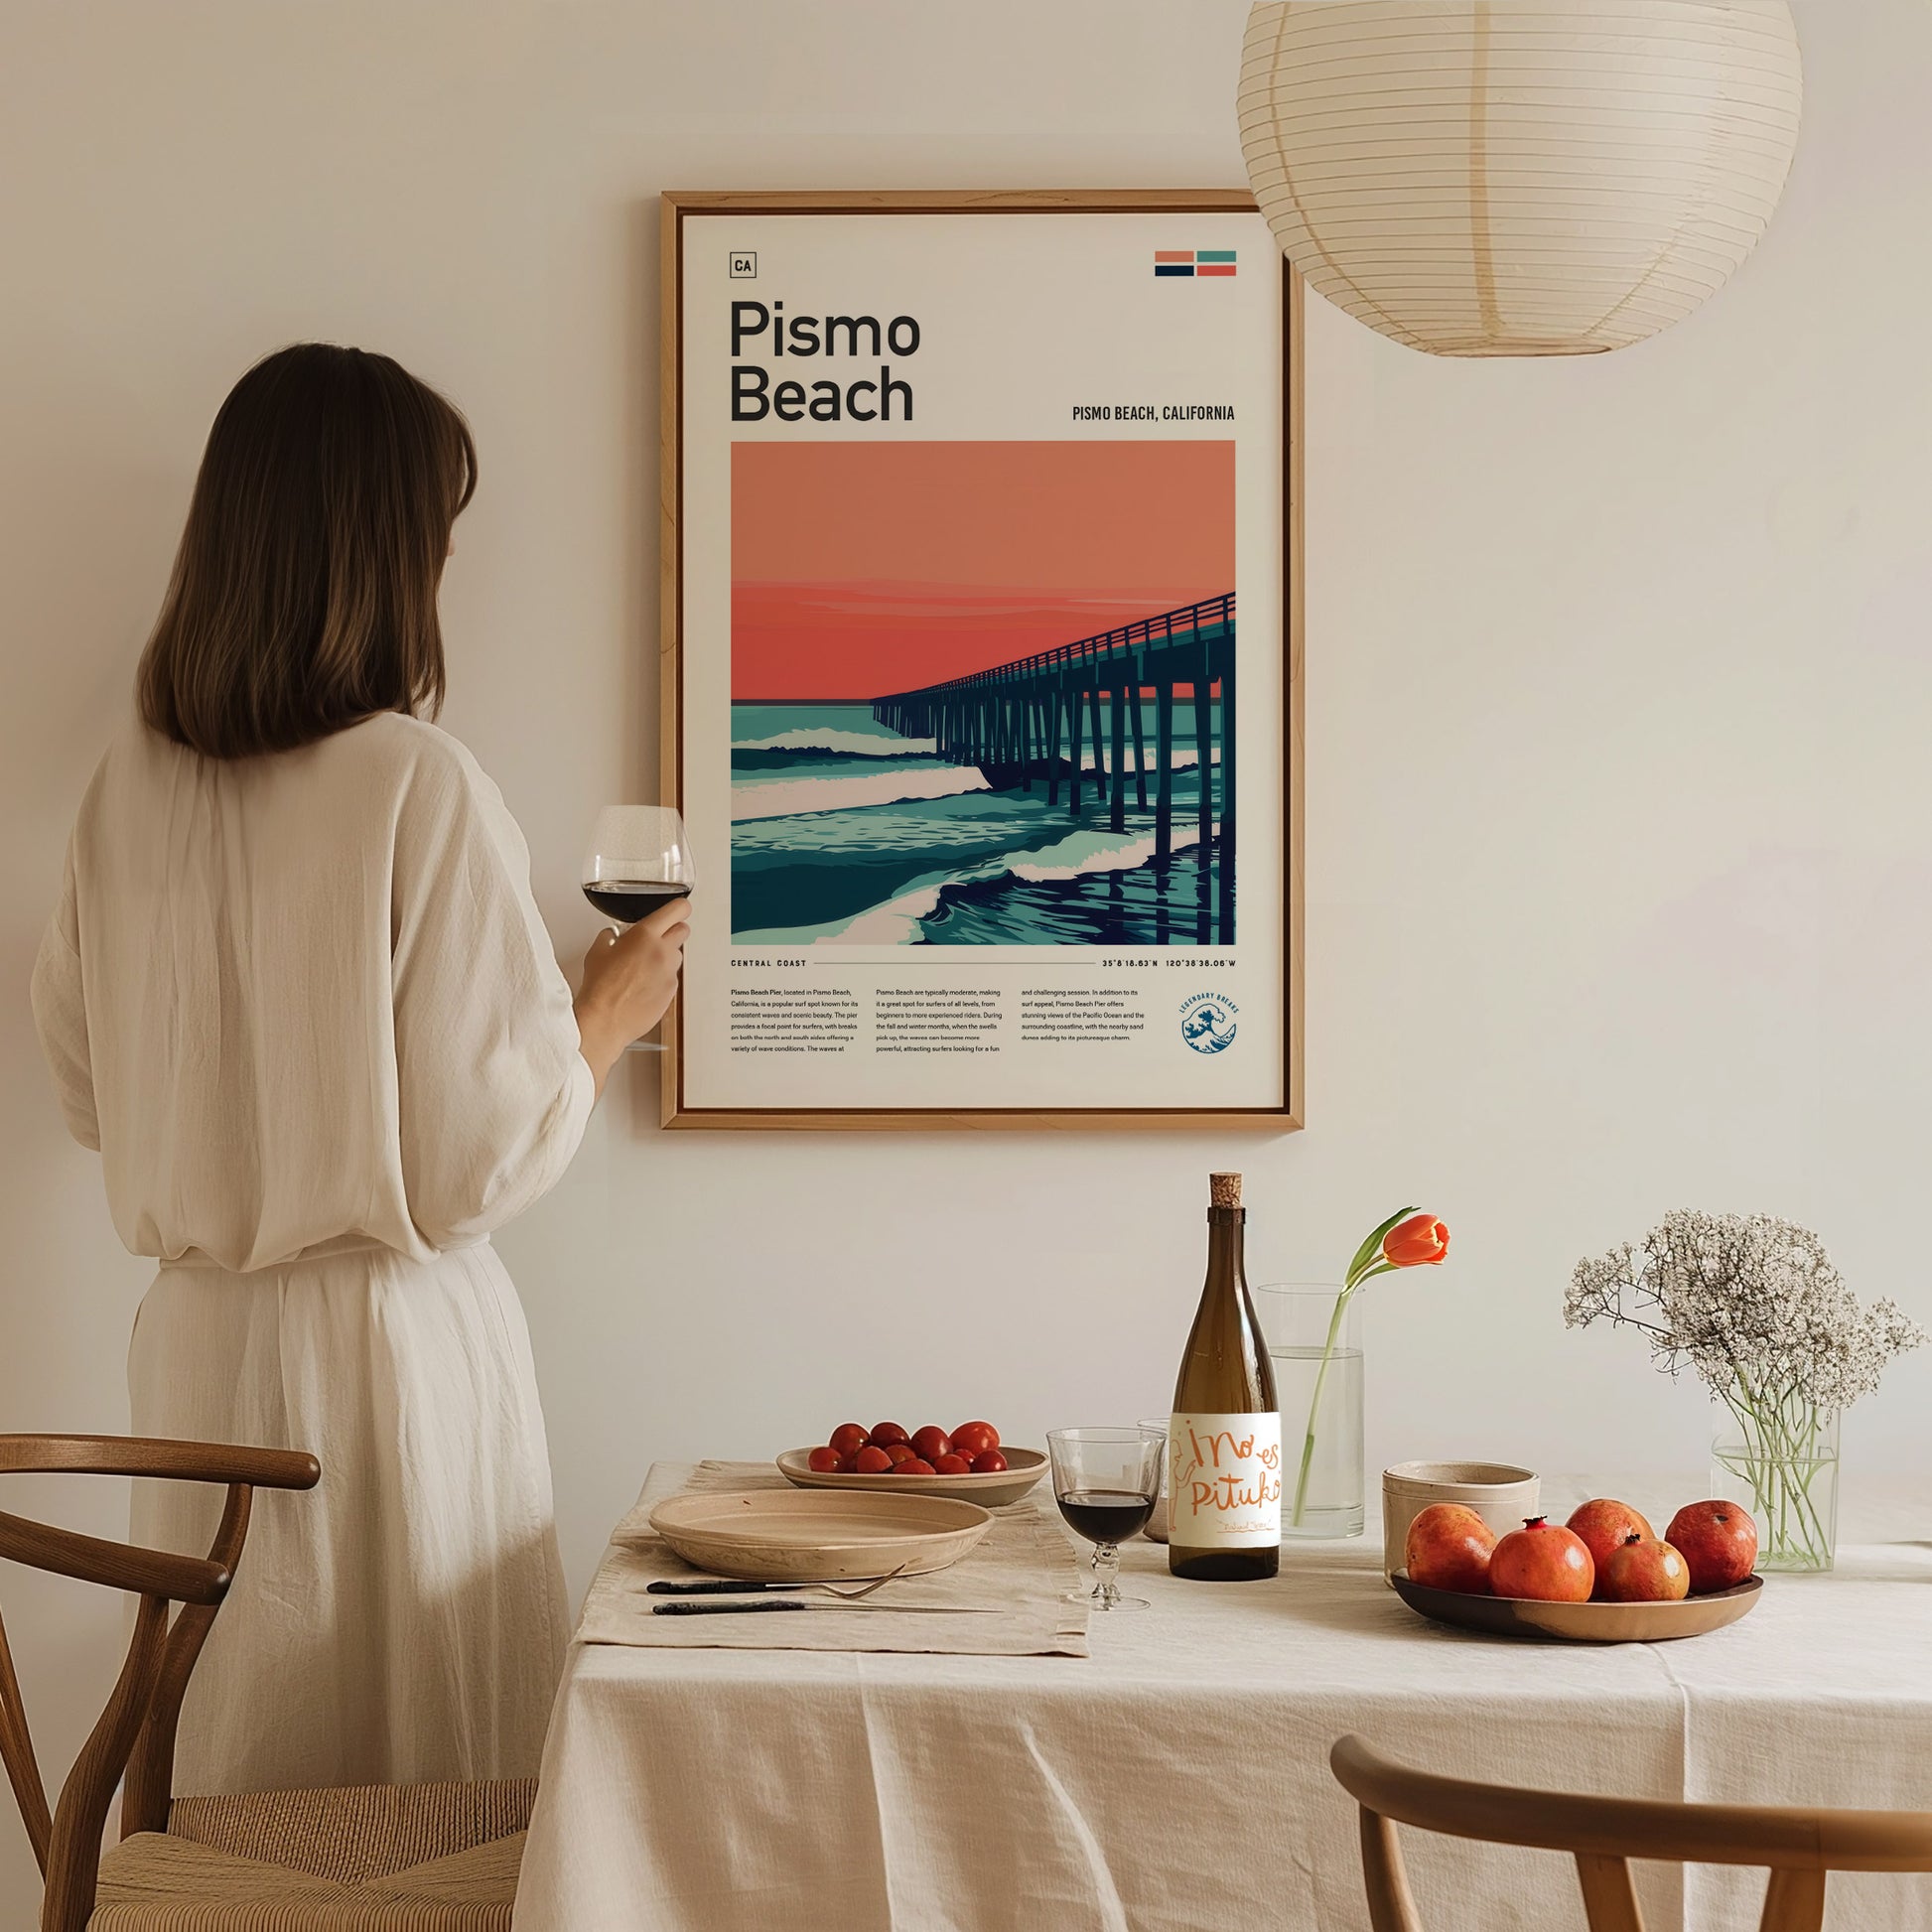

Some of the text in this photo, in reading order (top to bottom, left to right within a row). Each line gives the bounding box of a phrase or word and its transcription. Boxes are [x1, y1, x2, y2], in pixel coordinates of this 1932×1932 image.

[735, 260, 752, 271] CA
[731, 301, 920, 356] Pismo
[731, 365, 912, 421] Beach
[1072, 406, 1235, 423] PISMO BEACH, CALIFORNIA
[1179, 993, 1239, 1014] LEGENDARY BREAKS
[1257, 1444, 1279, 1469] es
